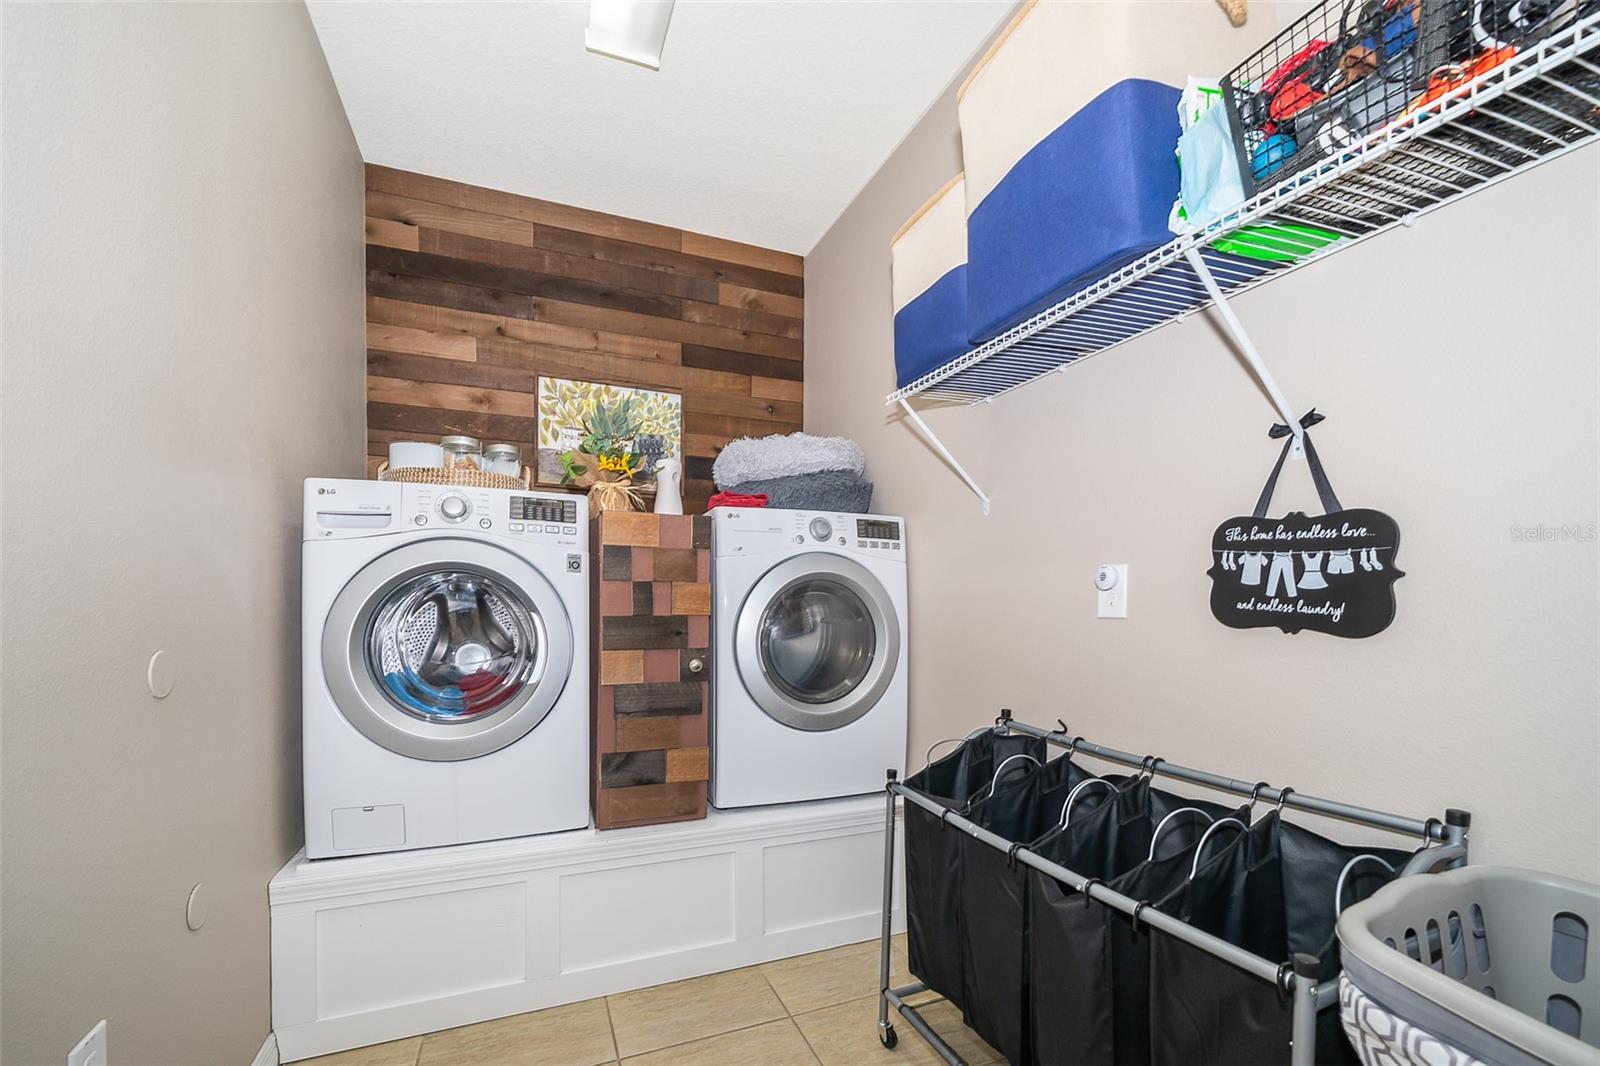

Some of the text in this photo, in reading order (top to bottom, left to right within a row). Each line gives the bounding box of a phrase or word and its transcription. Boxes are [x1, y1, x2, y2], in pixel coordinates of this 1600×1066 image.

[1225, 522, 1376, 542] This home has endless love...
[1236, 597, 1346, 623] and endless laundry!
